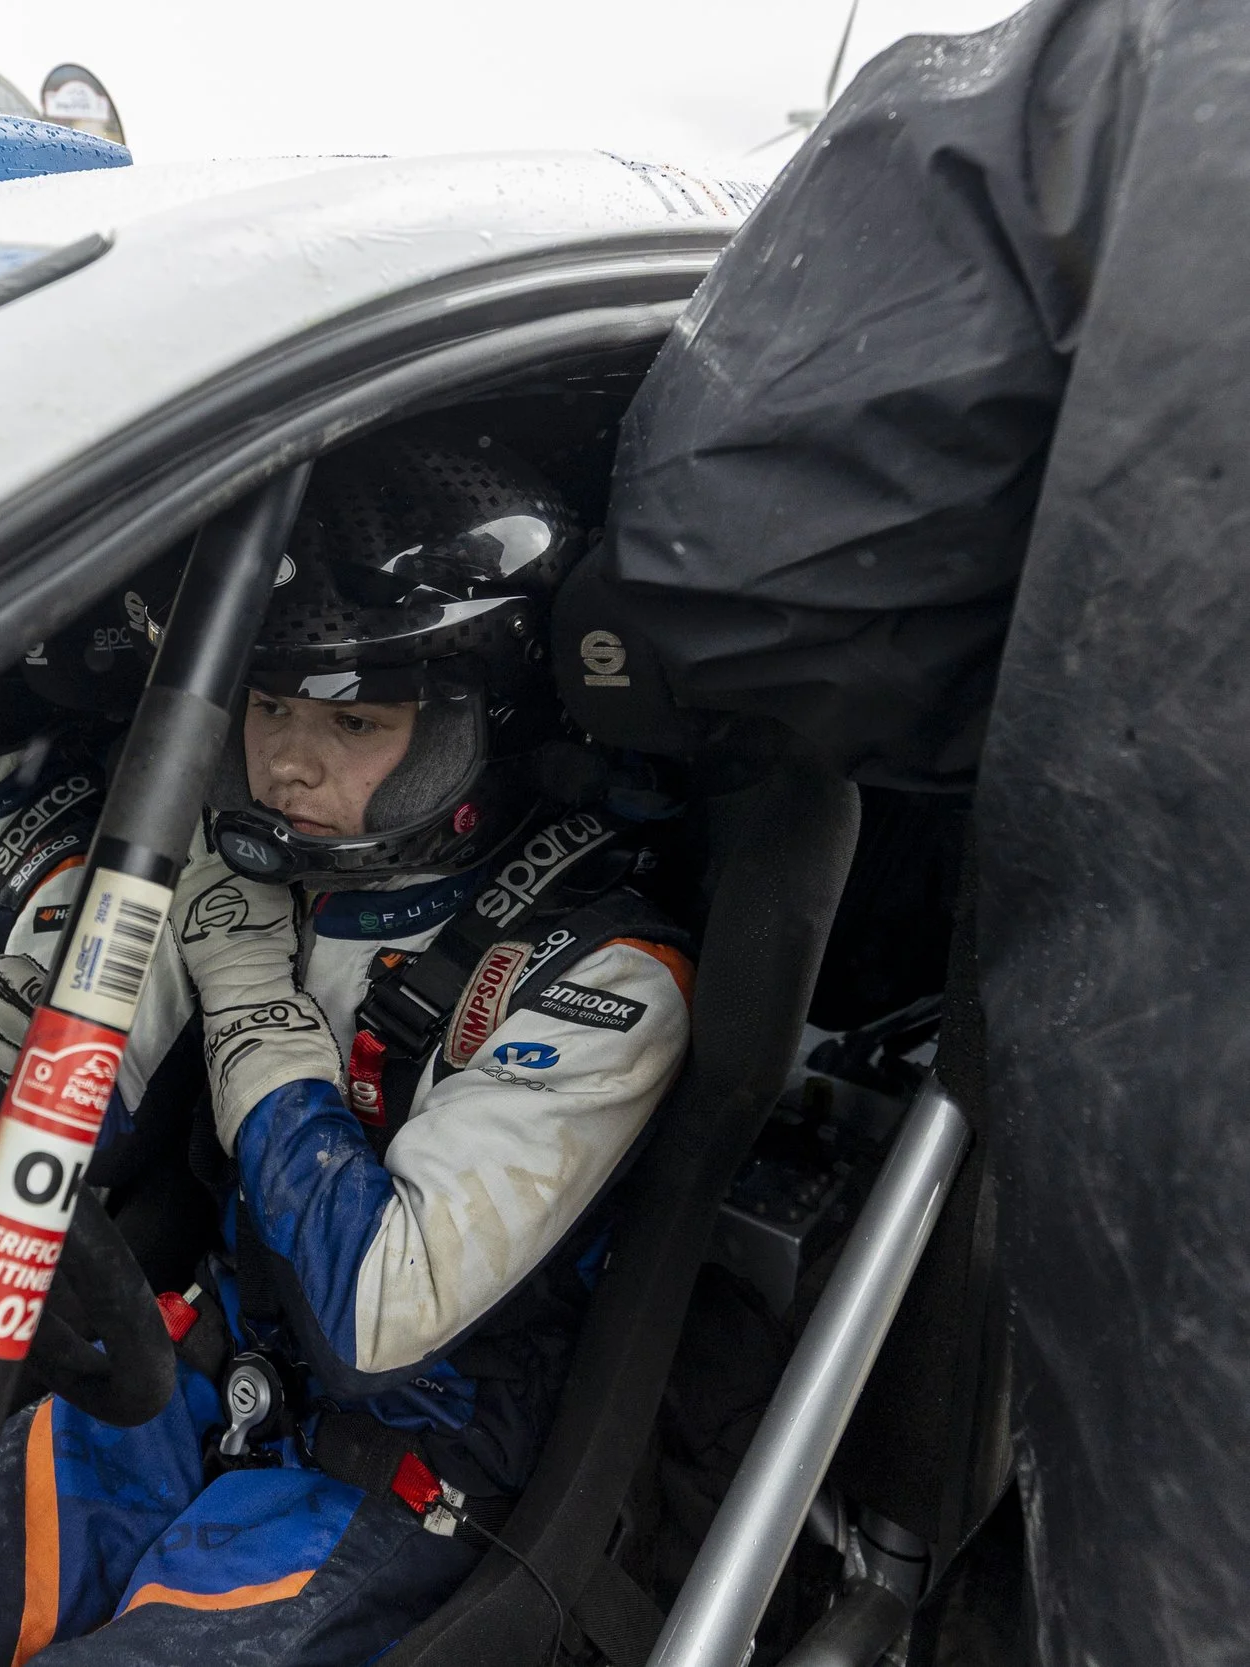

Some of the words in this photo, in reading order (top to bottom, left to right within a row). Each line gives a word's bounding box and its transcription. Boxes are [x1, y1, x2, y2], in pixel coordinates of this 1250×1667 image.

[9, 834, 80, 893] sparco
[476, 813, 616, 928] sparco
[459, 954, 512, 1056] SIMPSON
[541, 1000, 577, 1017] driving
[578, 1010, 626, 1027] emotion
